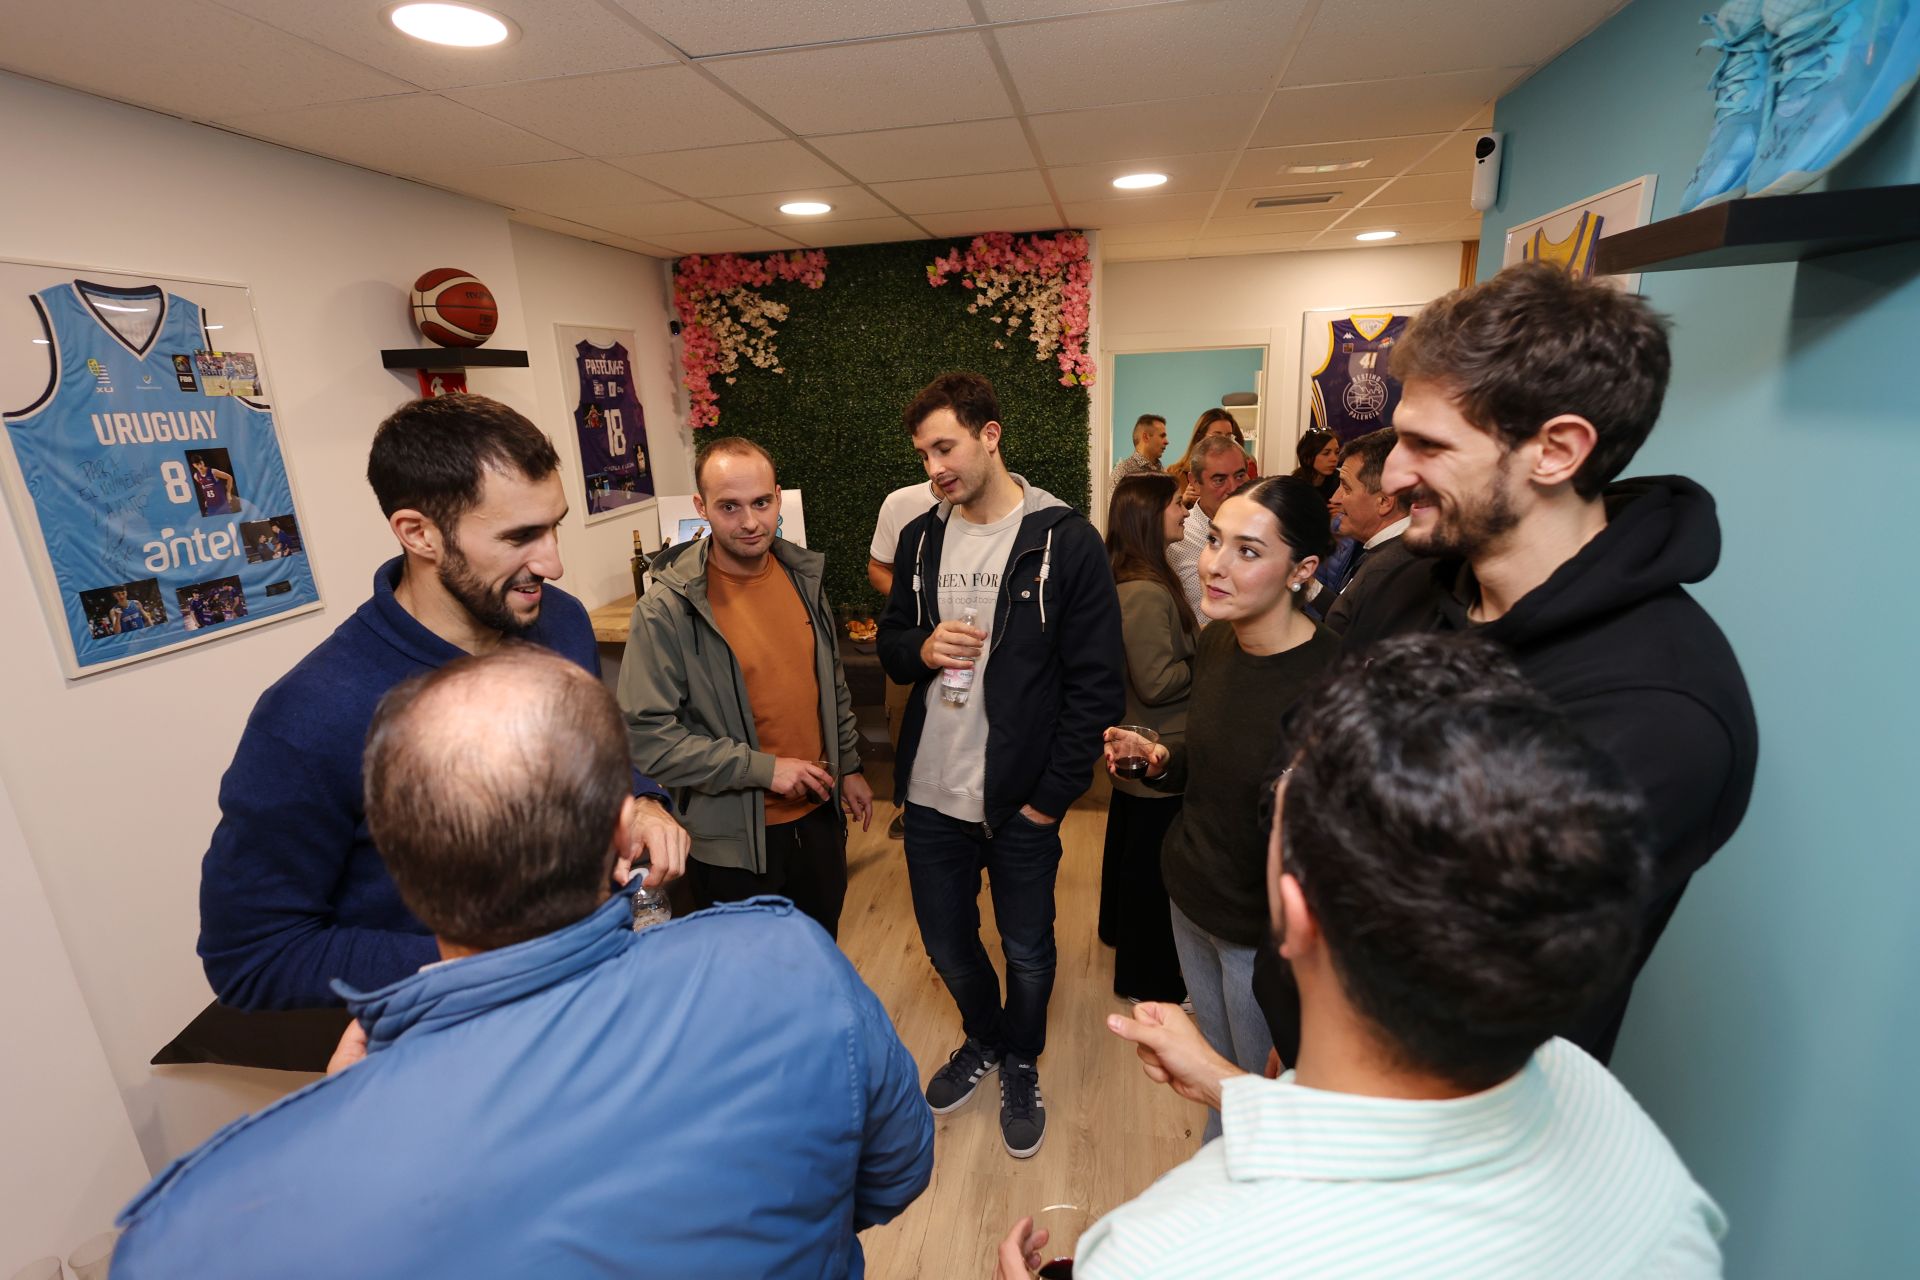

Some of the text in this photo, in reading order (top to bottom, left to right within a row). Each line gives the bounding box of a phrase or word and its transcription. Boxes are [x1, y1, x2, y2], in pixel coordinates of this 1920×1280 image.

[1359, 352, 1378, 368] 41
[91, 410, 217, 446] URUGUAY
[604, 409, 626, 457] 18
[1348, 411, 1380, 420] PALENCIA
[160, 460, 193, 504] 8
[143, 521, 241, 573] antel
[973, 572, 999, 587] FOR
